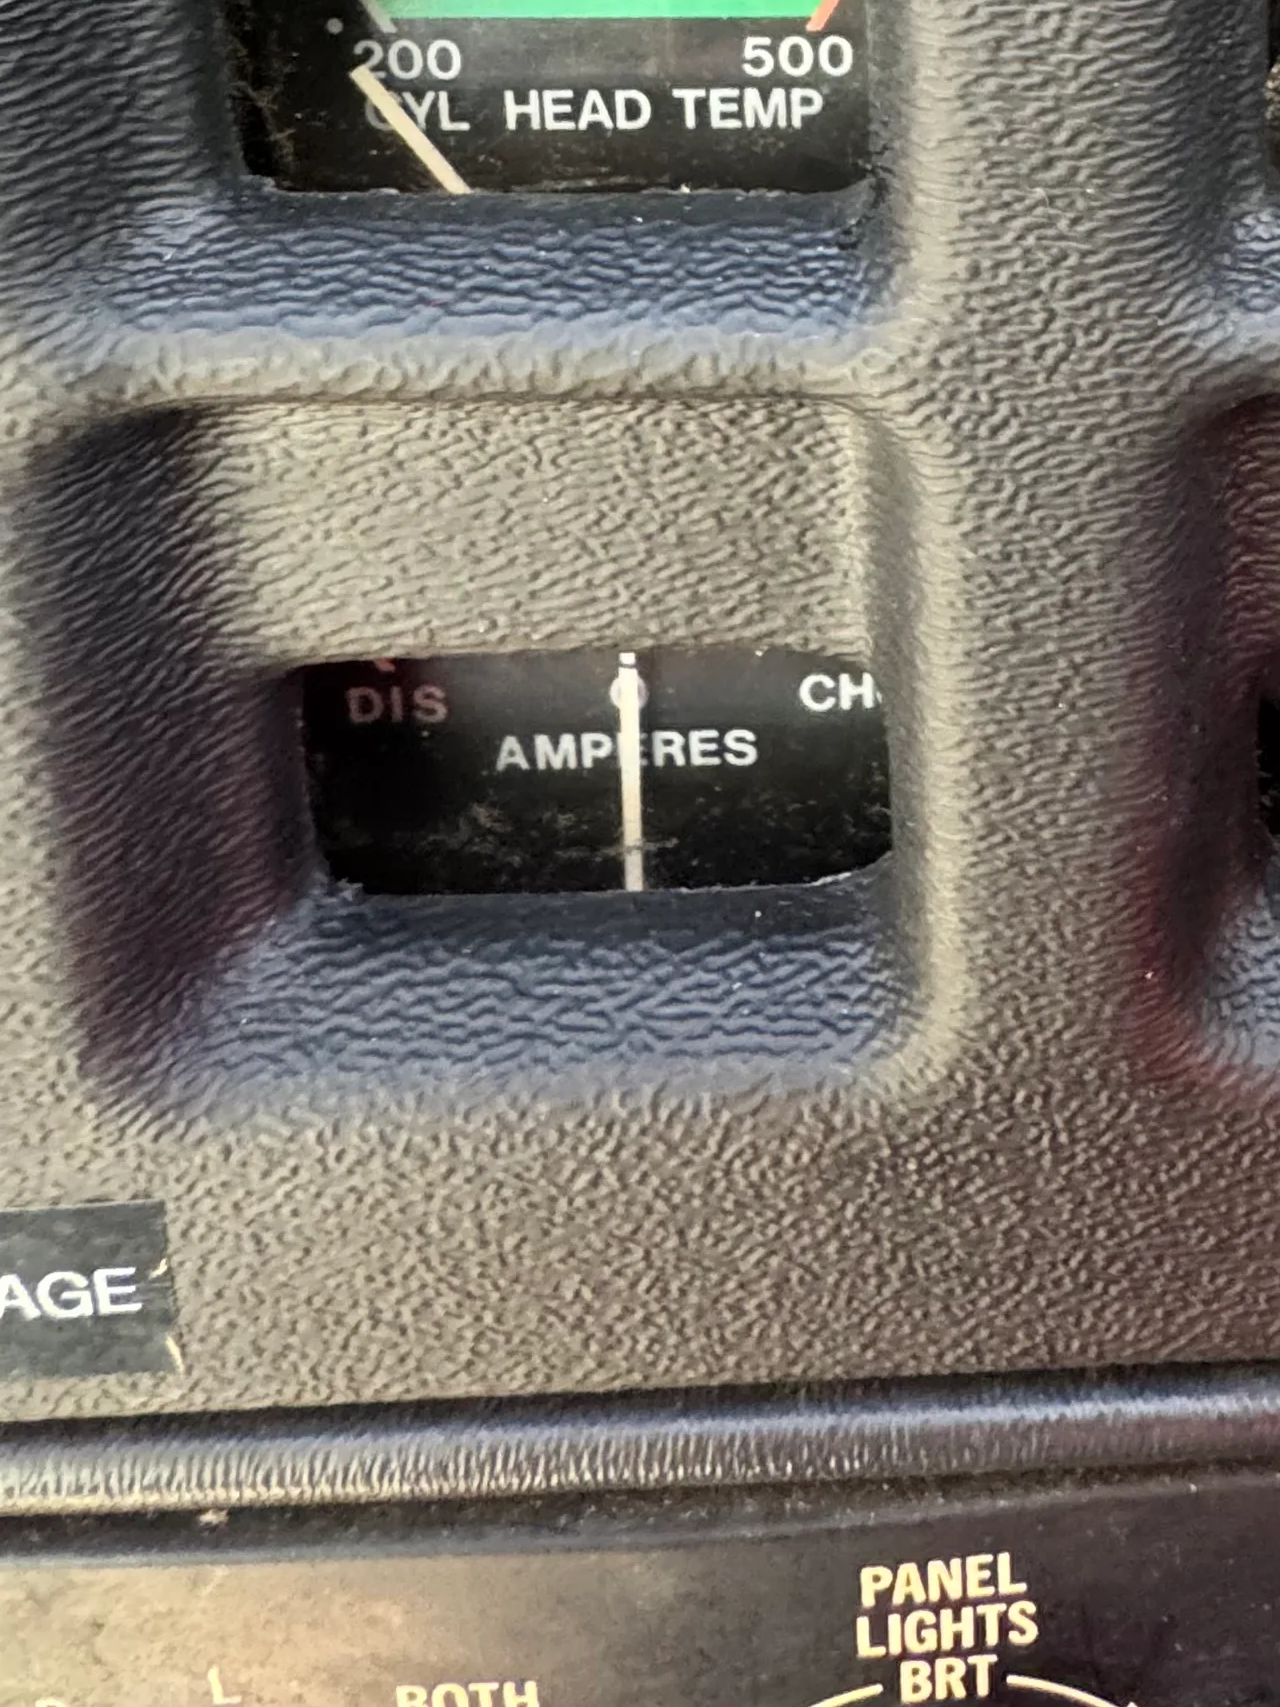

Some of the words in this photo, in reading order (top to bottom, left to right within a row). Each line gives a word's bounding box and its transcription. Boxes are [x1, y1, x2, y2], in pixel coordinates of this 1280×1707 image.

[353, 38, 462, 81] 200
[741, 34, 855, 78] 500
[504, 87, 652, 131] HEAD
[671, 86, 824, 130] TEMP
[346, 684, 449, 724] DIS
[799, 672, 883, 712] CH
[0, 1266, 143, 1321] AGE
[860, 1551, 1027, 1610] PANEL
[856, 1602, 1040, 1660] LIGHTS
[898, 1654, 998, 1707] BRT
